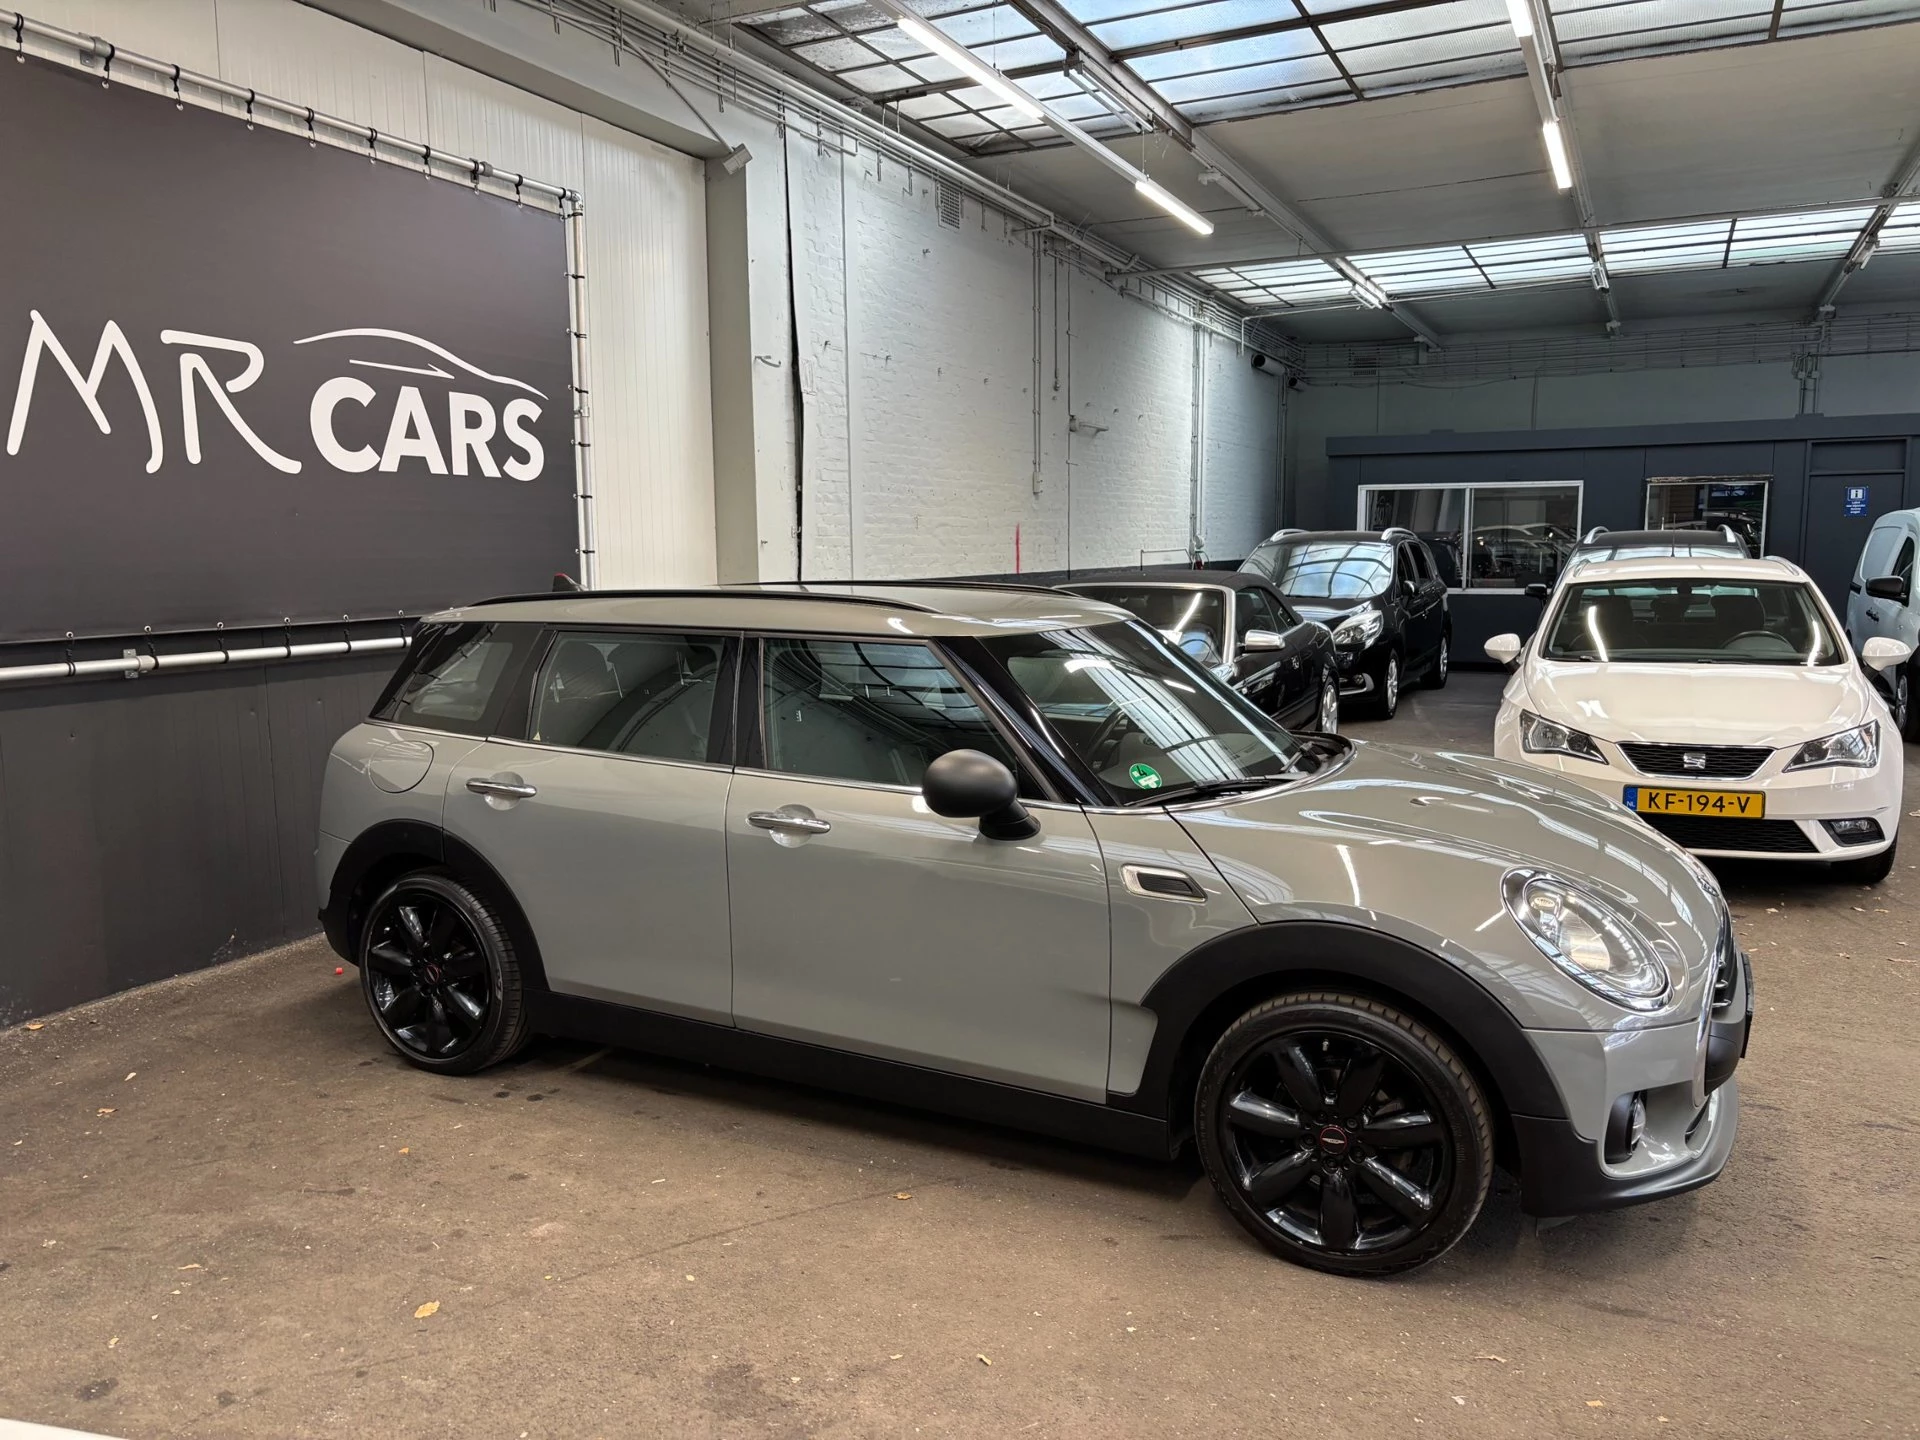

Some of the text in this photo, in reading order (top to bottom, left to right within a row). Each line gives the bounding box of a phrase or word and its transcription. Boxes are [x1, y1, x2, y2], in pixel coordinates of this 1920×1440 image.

[6, 309, 545, 482] MR CARS
[1626, 800, 1636, 808] NL
[1648, 791, 1750, 813] KF-194-V
